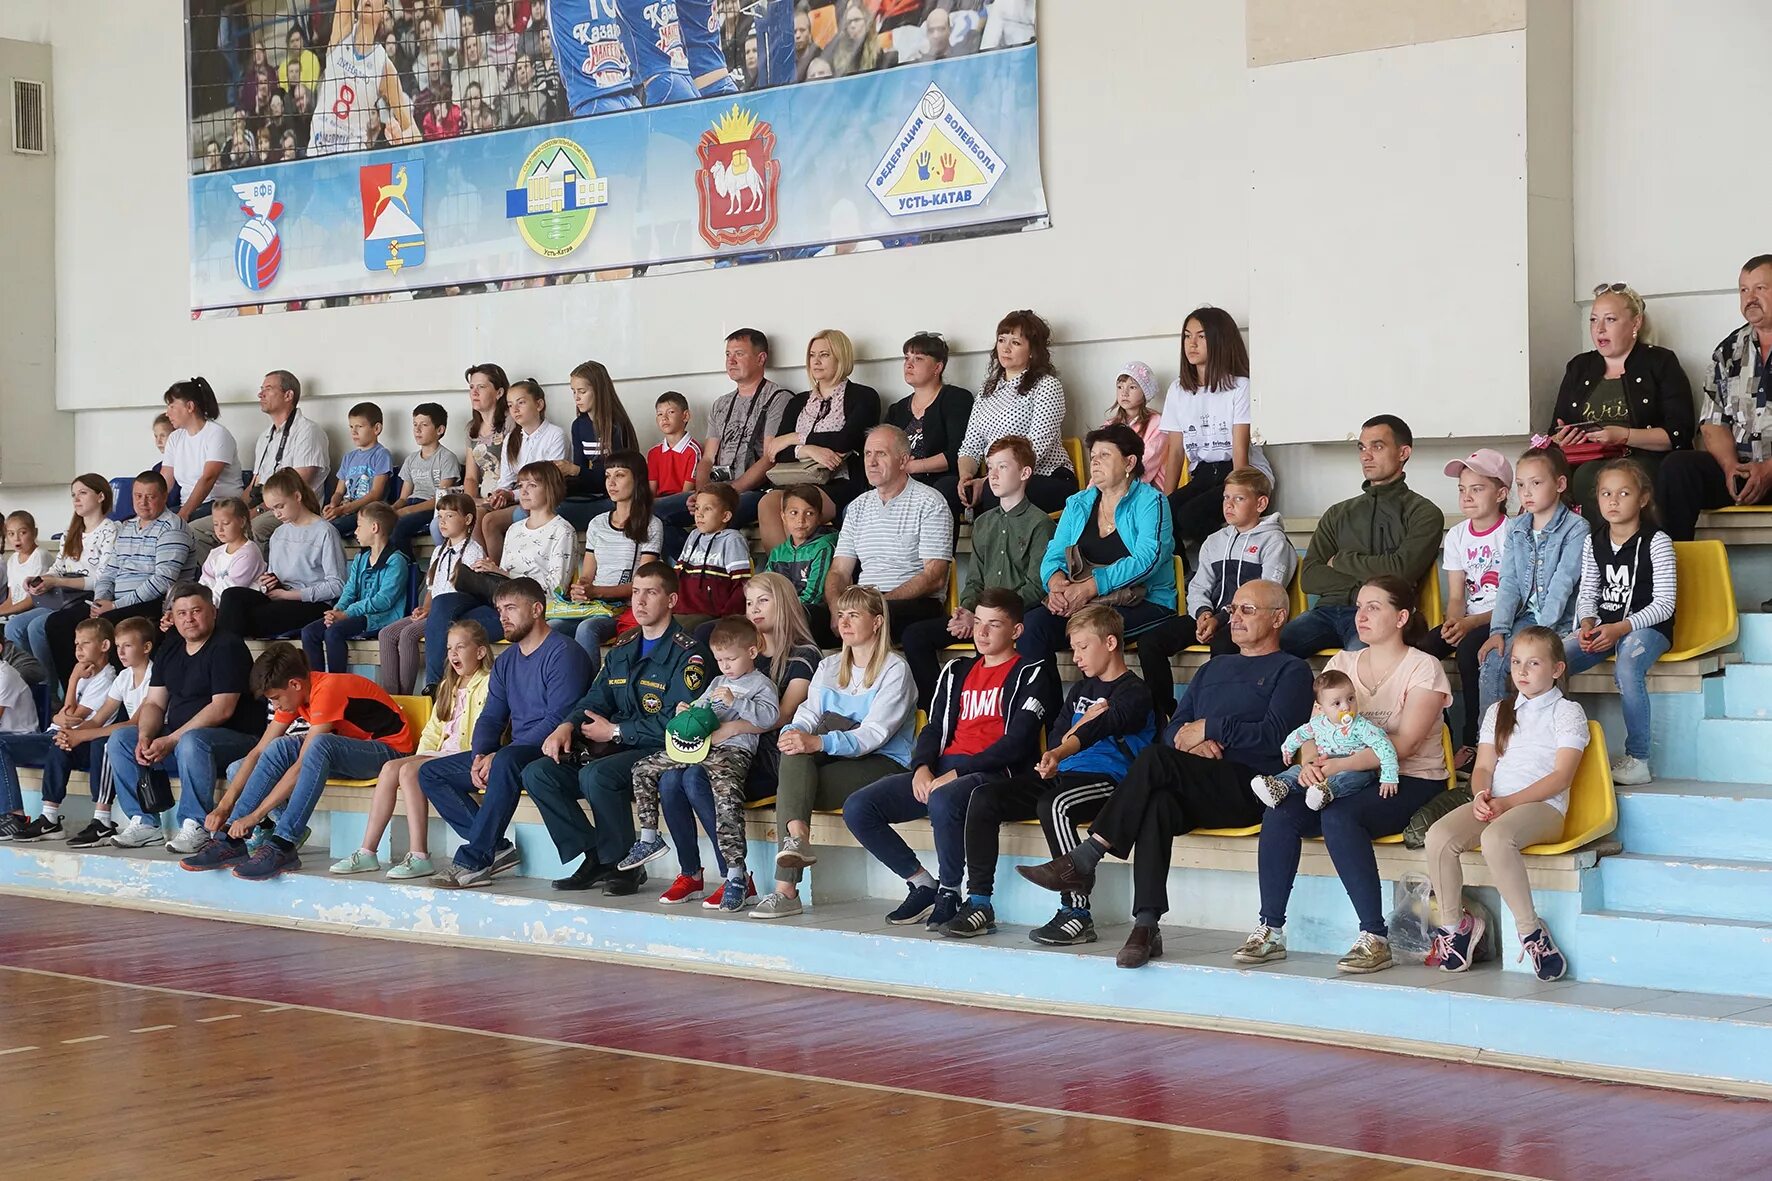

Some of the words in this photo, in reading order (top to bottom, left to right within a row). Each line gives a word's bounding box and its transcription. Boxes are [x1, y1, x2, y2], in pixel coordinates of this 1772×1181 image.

[333, 84, 355, 119] 8
[876, 118, 924, 186] ФЕДЕРАЦИЯ
[944, 113, 996, 174] ВОЛЕЙБОЛА
[899, 190, 972, 210] УСТЬ-КАТАВ
[1021, 696, 1046, 720] NIKE
